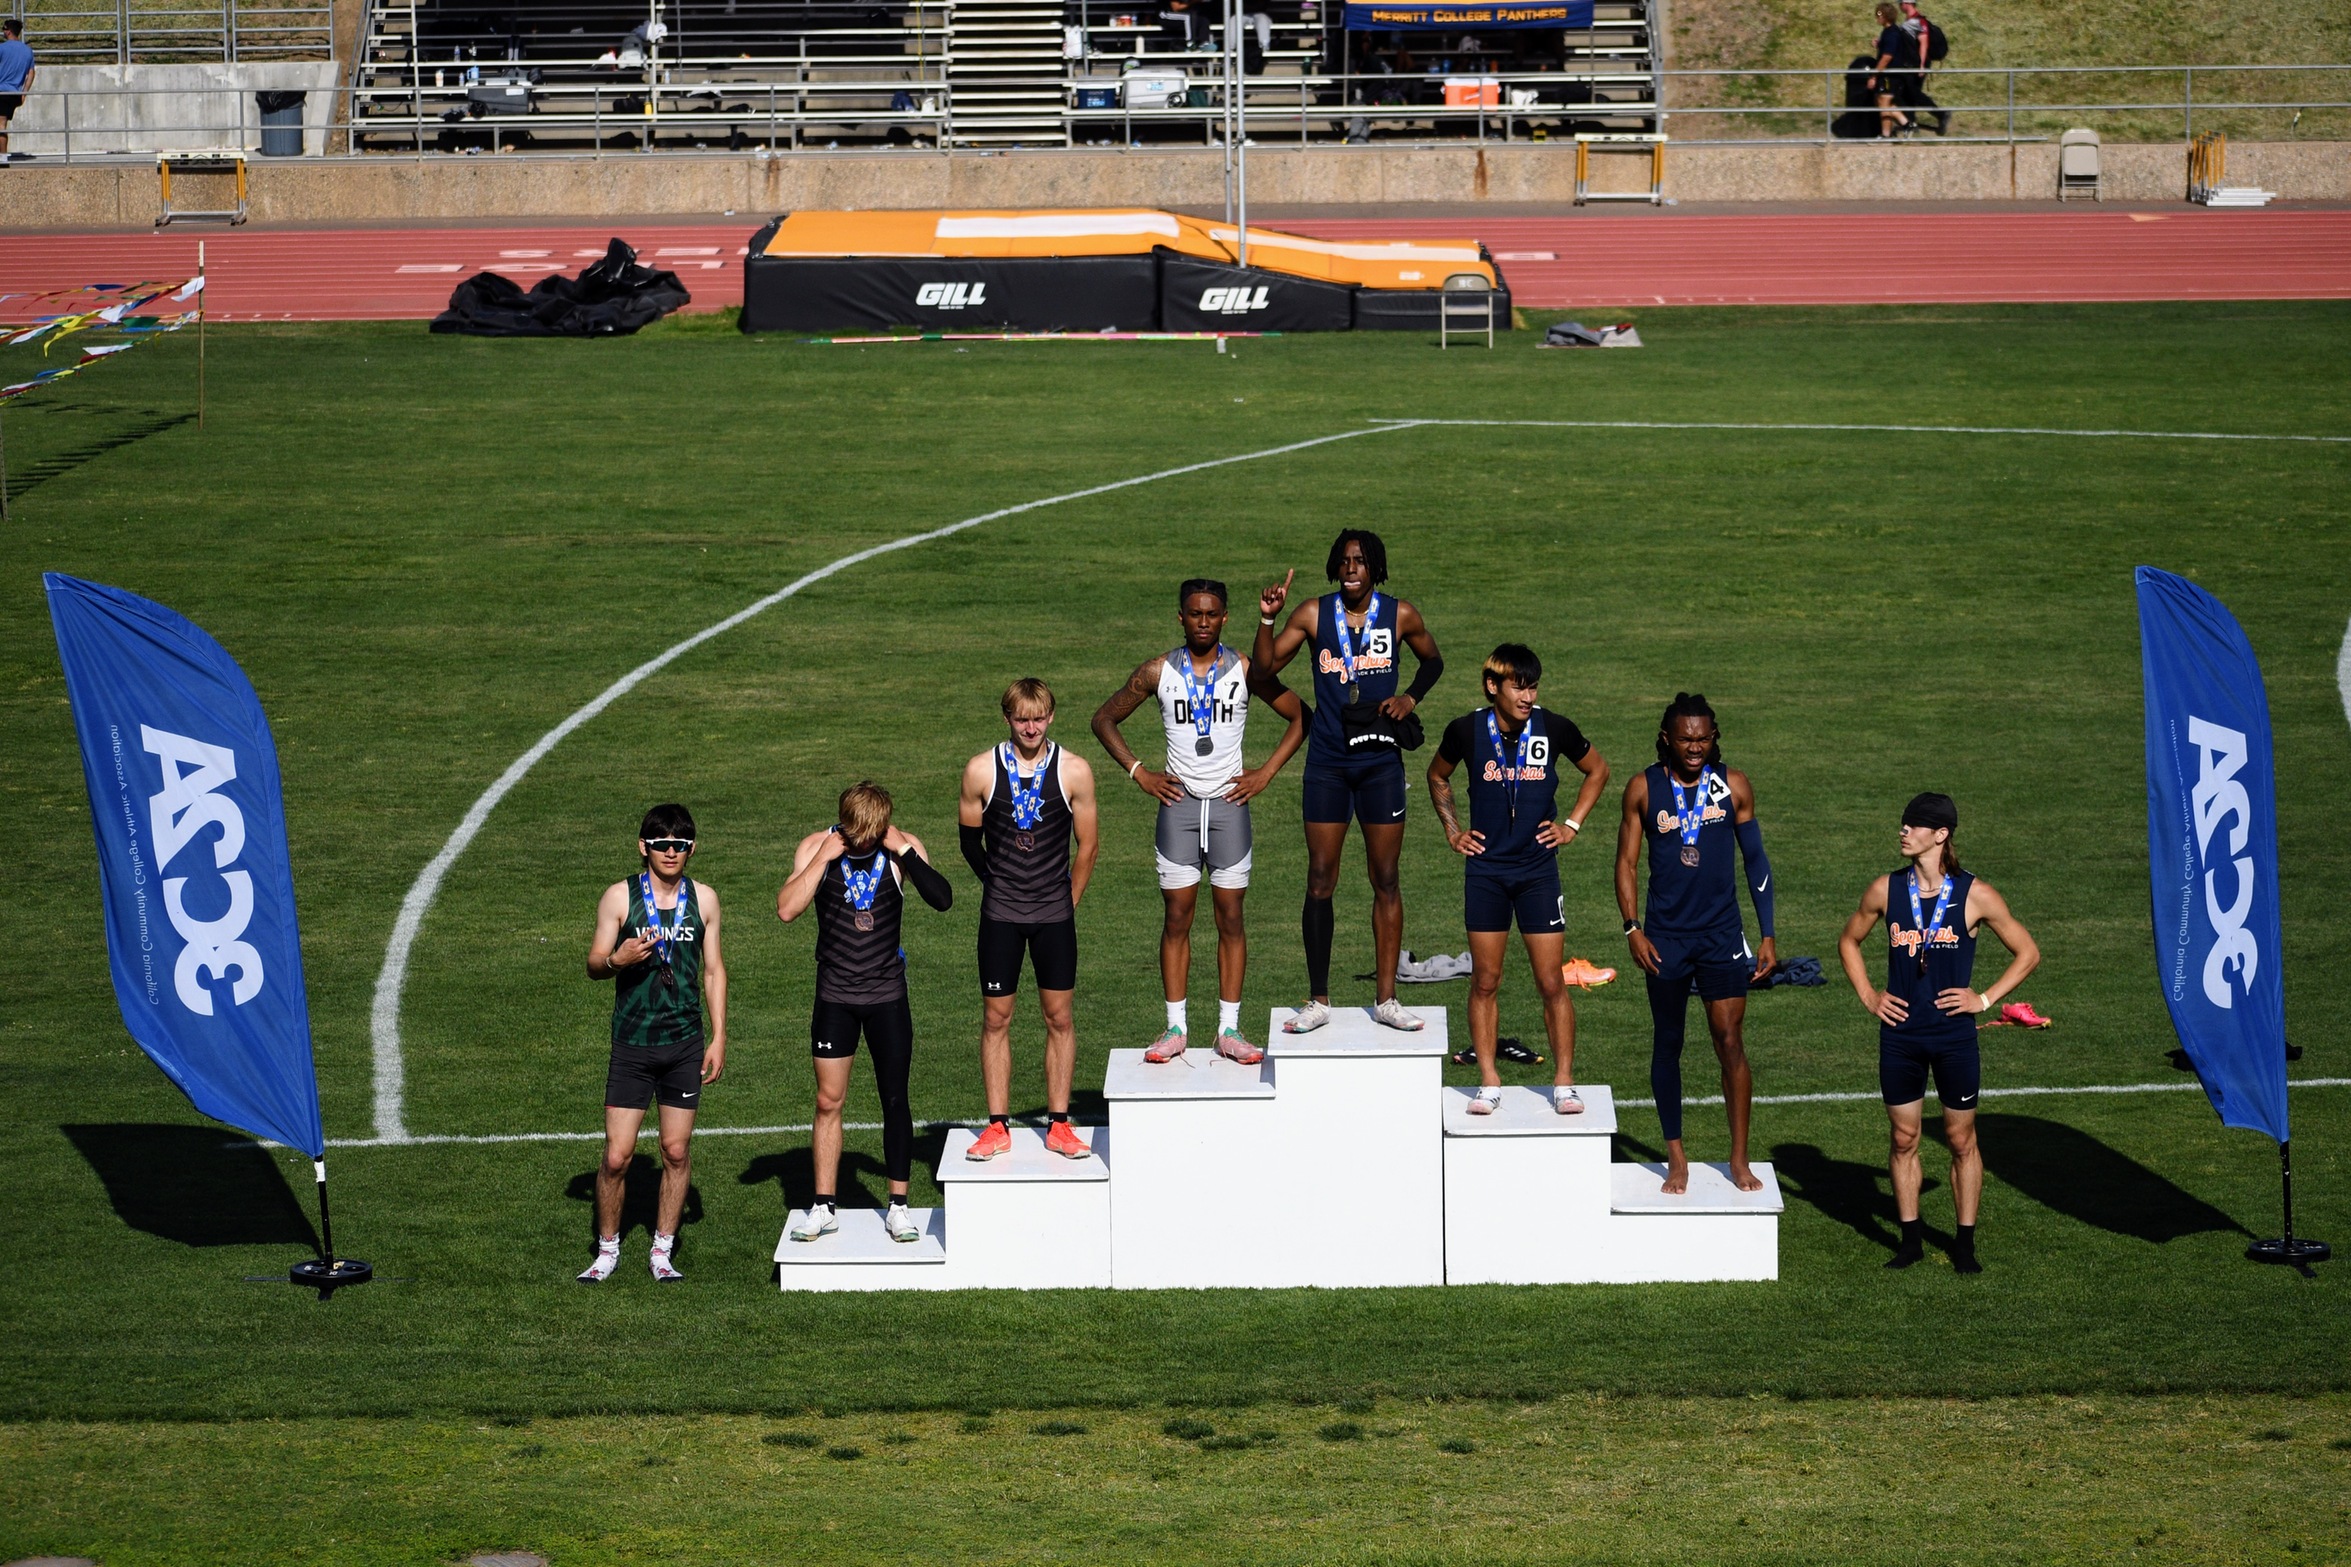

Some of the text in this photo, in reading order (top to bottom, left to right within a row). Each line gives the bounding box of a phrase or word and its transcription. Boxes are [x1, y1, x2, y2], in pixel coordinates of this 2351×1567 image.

[1372, 8, 1568, 23] MERRITT COLLEGE PANTHERS
[915, 282, 987, 306] GILL
[1198, 286, 1270, 311] GILL
[1373, 635, 1388, 654] 5
[1531, 740, 1546, 760] 6
[1710, 779, 1724, 795] 4
[635, 927, 695, 942] VIINGS
